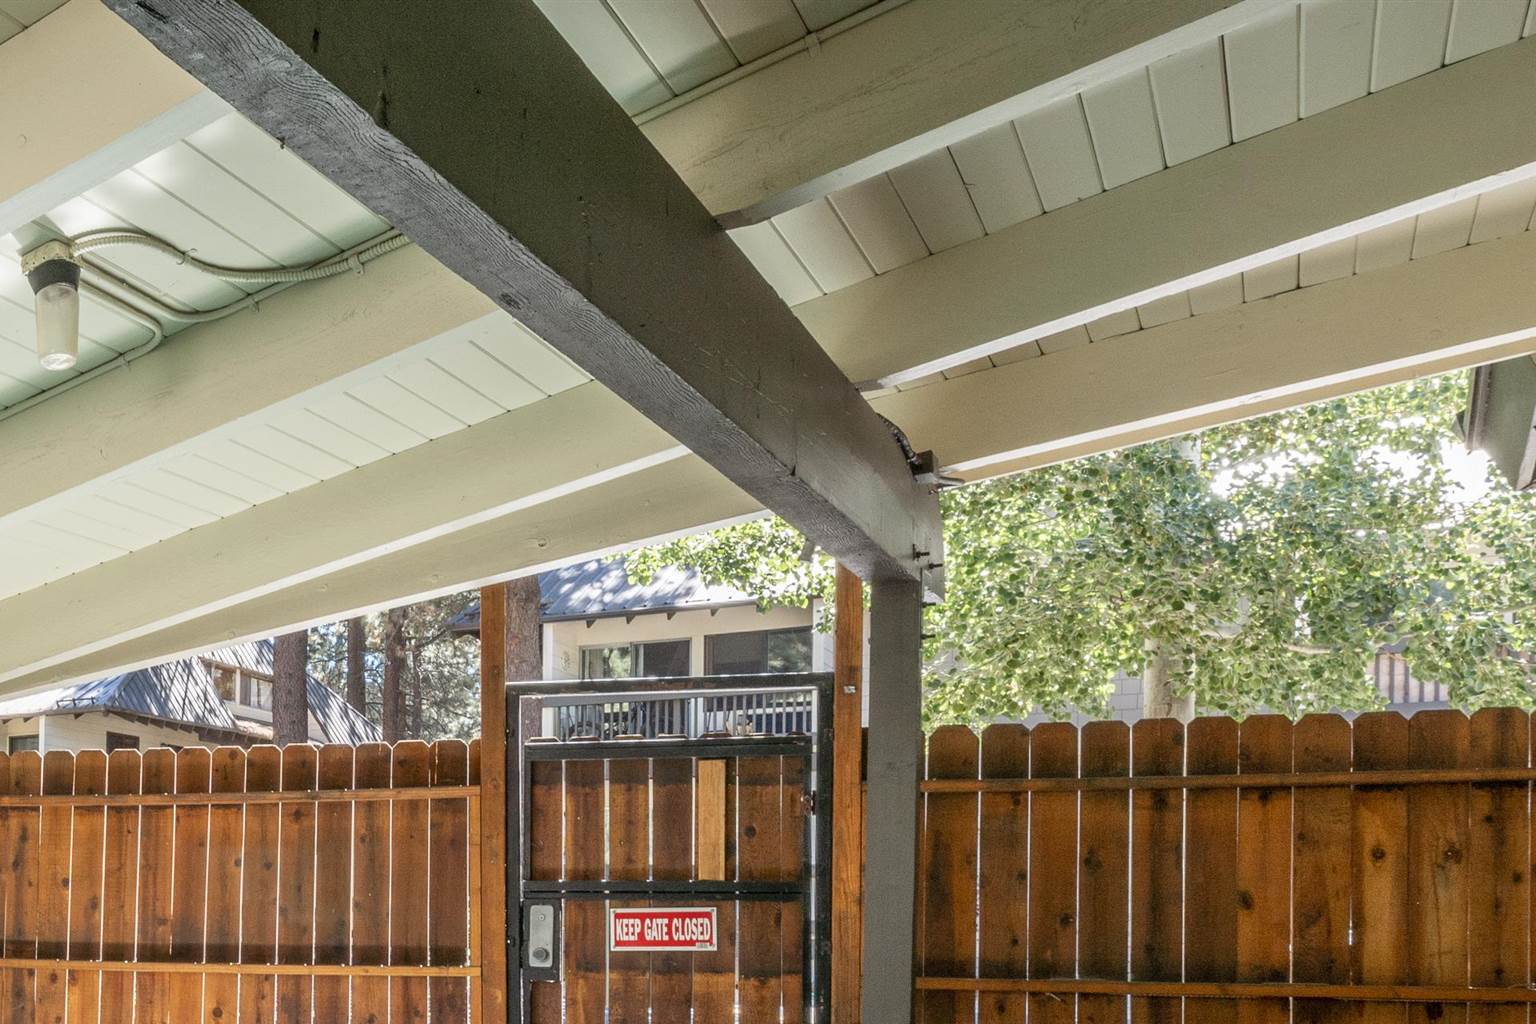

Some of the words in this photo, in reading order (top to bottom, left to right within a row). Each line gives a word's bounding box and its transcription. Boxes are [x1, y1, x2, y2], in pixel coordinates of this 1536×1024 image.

[616, 918, 641, 941] KEEP
[644, 918, 669, 941] GATE
[672, 918, 711, 941] CLOSED
